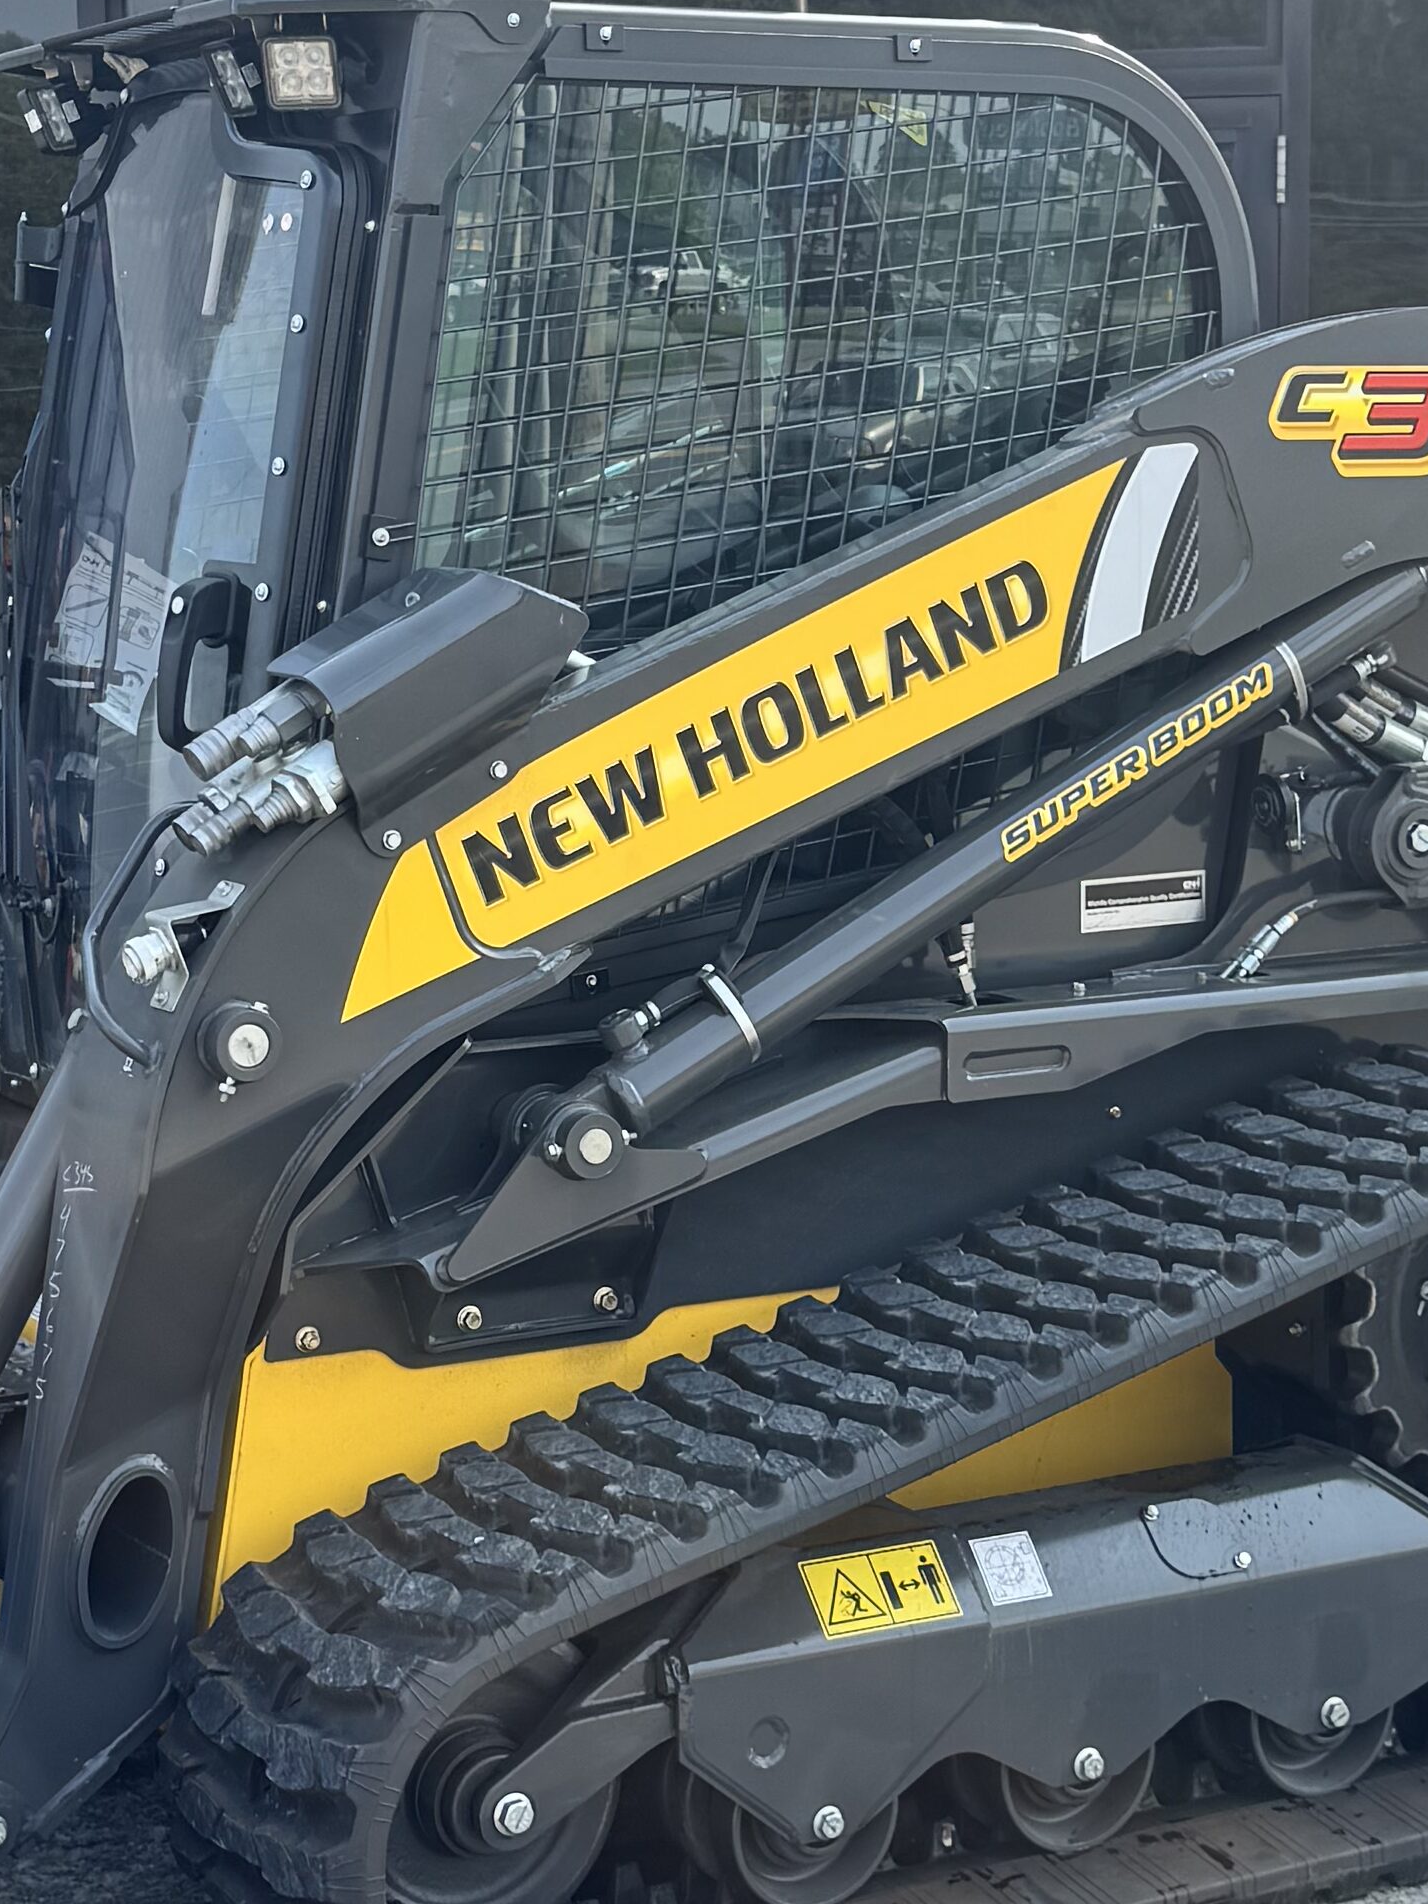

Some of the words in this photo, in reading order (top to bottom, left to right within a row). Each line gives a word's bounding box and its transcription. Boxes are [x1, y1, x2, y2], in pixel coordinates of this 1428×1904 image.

[461, 744, 665, 907] NEW
[676, 560, 1049, 800] HOLLAND
[1001, 744, 1149, 862] SUPER
[1148, 662, 1273, 767] BOOM
[62, 1161, 94, 1186] C345
